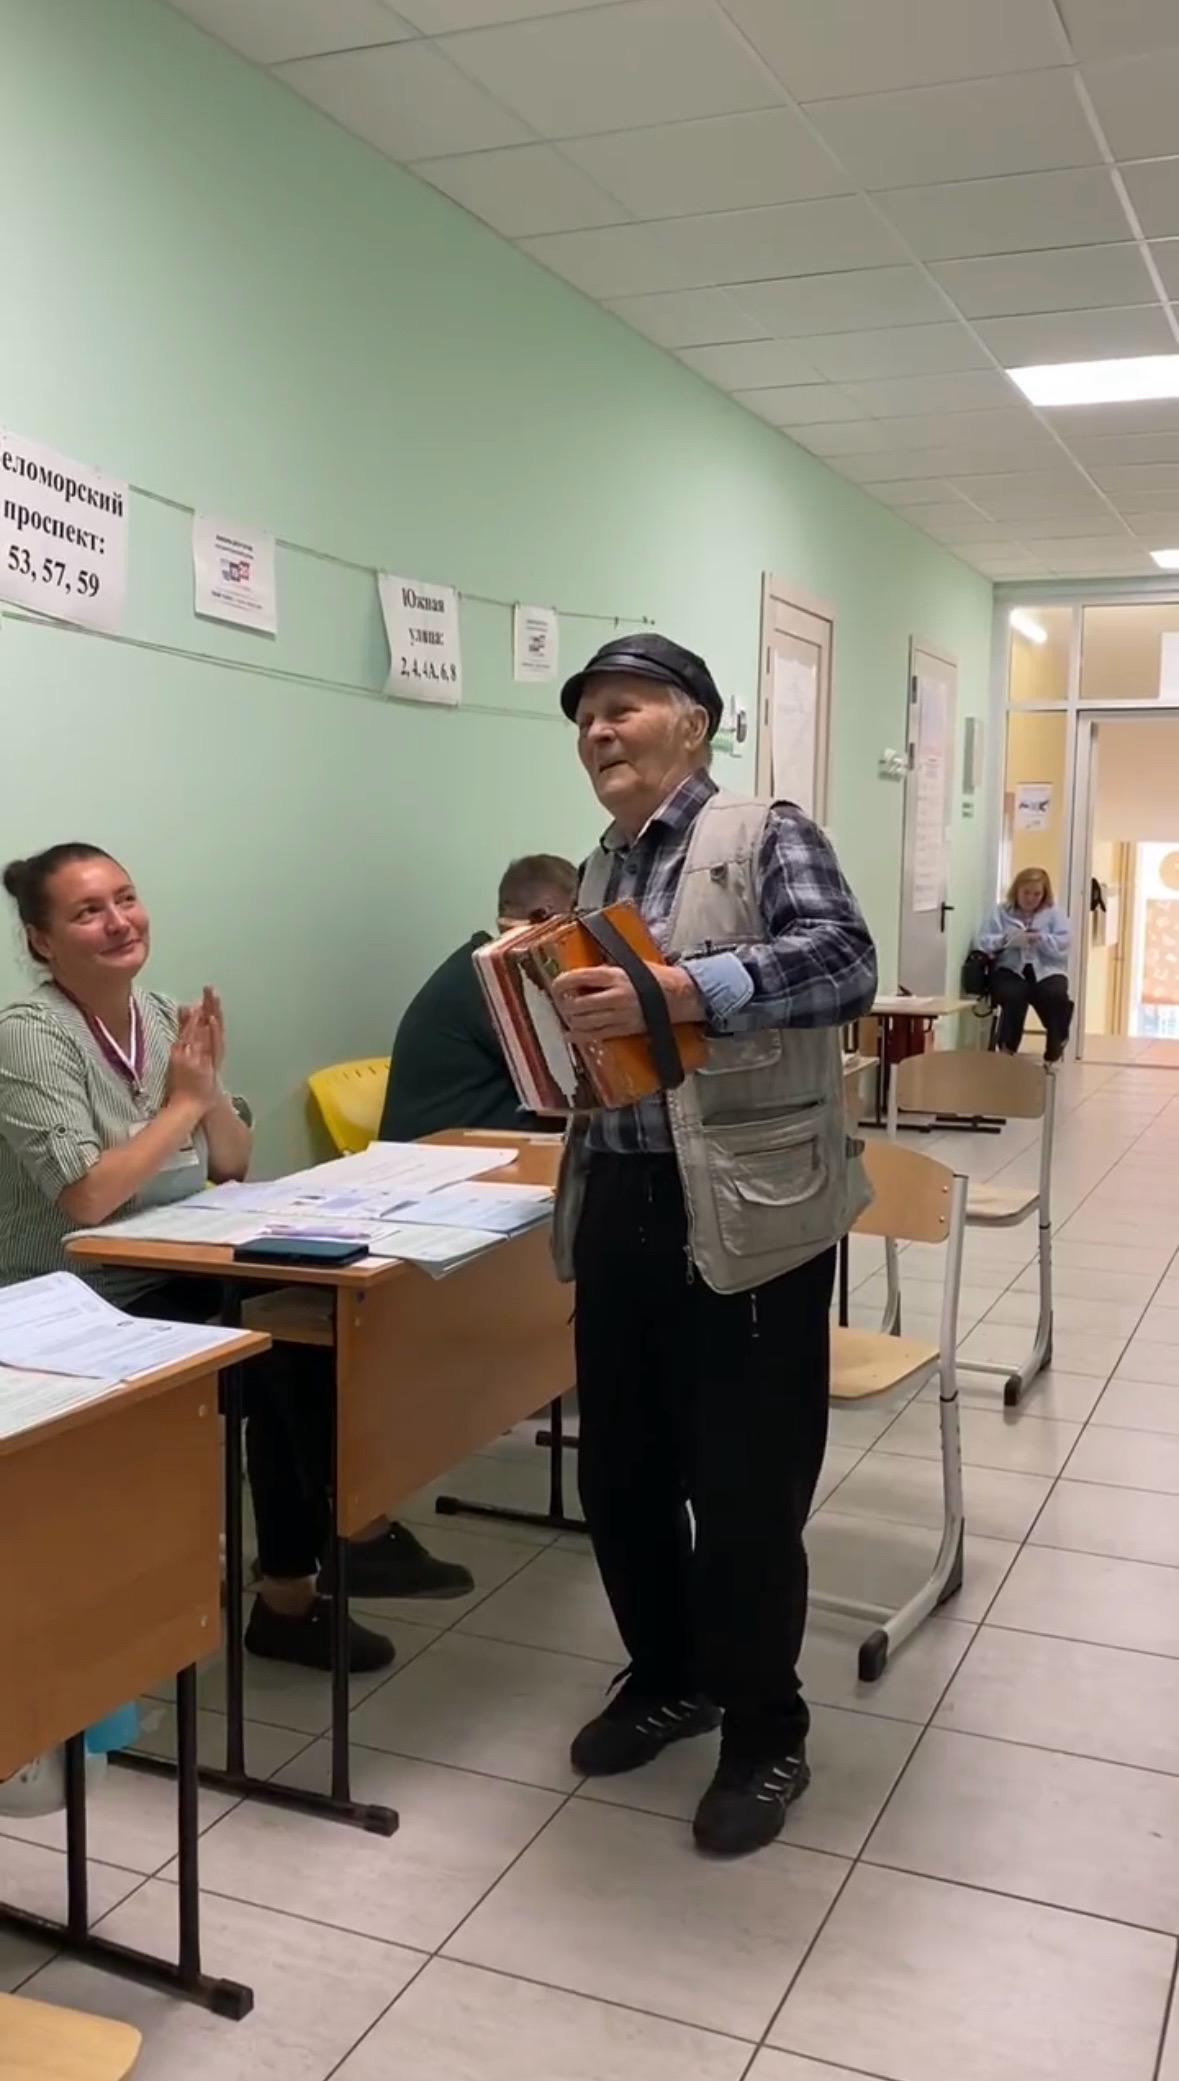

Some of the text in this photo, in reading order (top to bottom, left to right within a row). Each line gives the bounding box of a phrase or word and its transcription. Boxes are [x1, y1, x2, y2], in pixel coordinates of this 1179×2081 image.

[1, 450, 124, 517] еломорский
[3, 498, 106, 555] проспект:
[7, 544, 101, 598] 53, 57, 59
[401, 587, 445, 613] Южная
